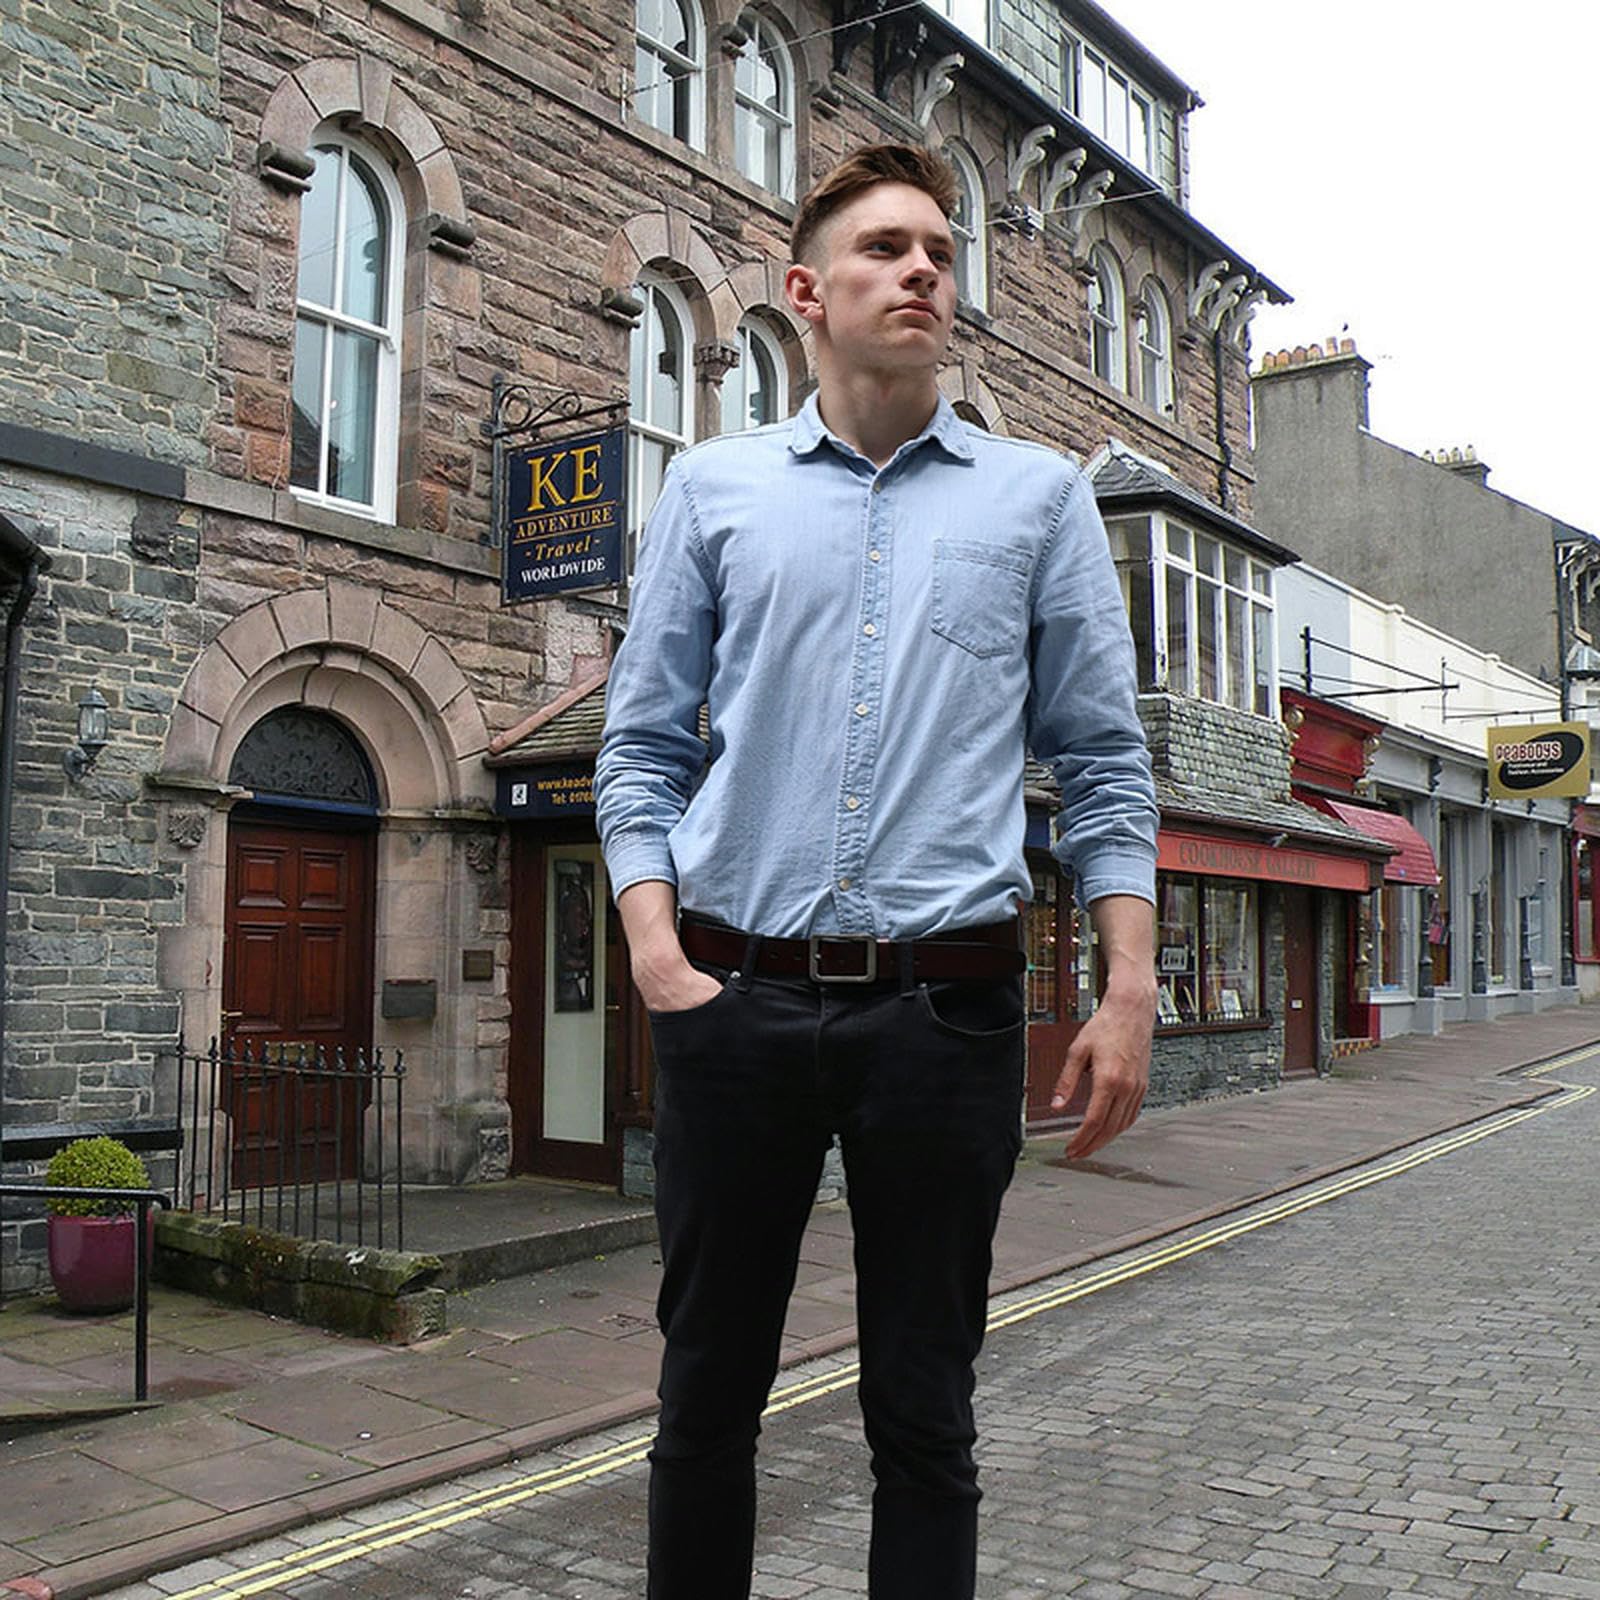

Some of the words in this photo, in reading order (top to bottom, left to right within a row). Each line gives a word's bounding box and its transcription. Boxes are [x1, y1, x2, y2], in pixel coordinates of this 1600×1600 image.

[527, 443, 604, 512] KE
[516, 506, 613, 539] ADVENTURE
[521, 557, 606, 584] WORLDWIDE
